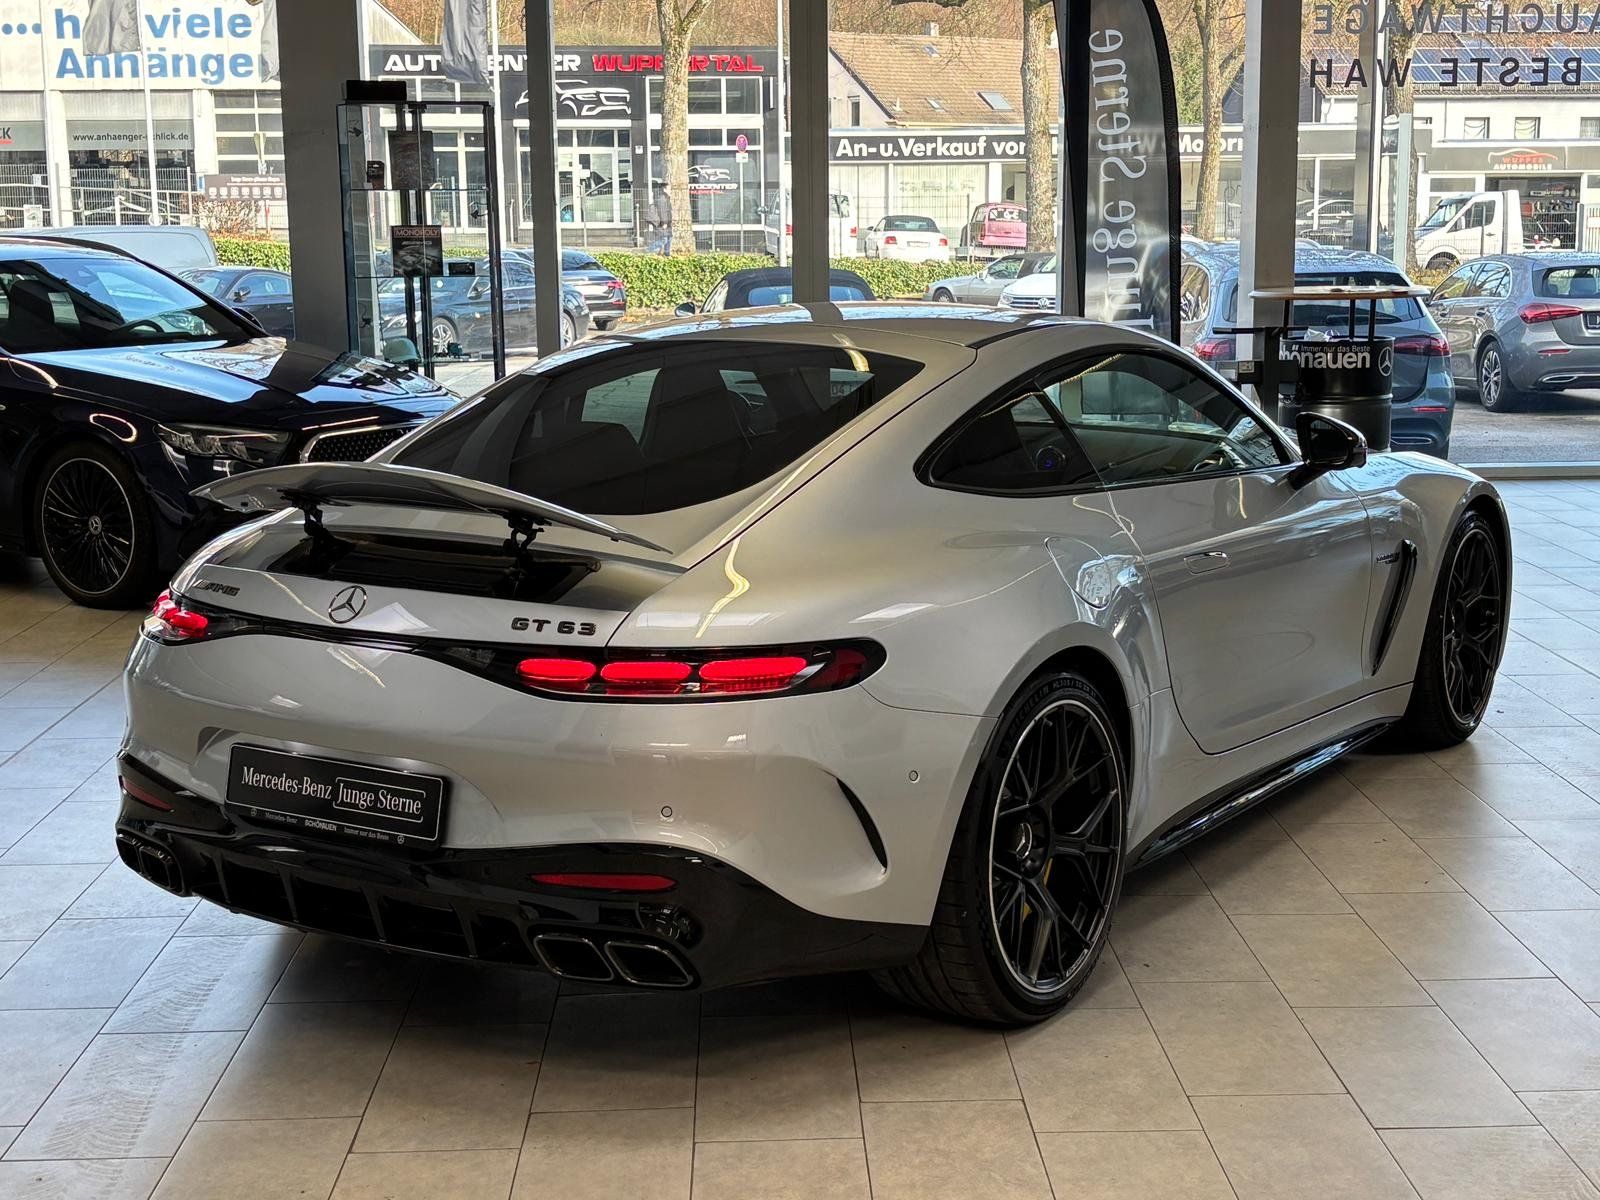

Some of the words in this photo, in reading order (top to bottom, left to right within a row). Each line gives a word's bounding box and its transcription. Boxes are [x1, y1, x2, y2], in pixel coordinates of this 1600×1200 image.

[145, 7, 252, 39] viele
[56, 47, 263, 85] Anhänge
[593, 54, 764, 72] WUPRTAL
[73, 132, 189, 142] www.anhaenger-hlick.de
[395, 228, 438, 236] MONOPOLY
[511, 617, 551, 632] GT
[557, 621, 596, 636] 63
[241, 766, 332, 800] Mercedes-Benz
[337, 782, 375, 810] Junge
[377, 789, 422, 815] Sterne
